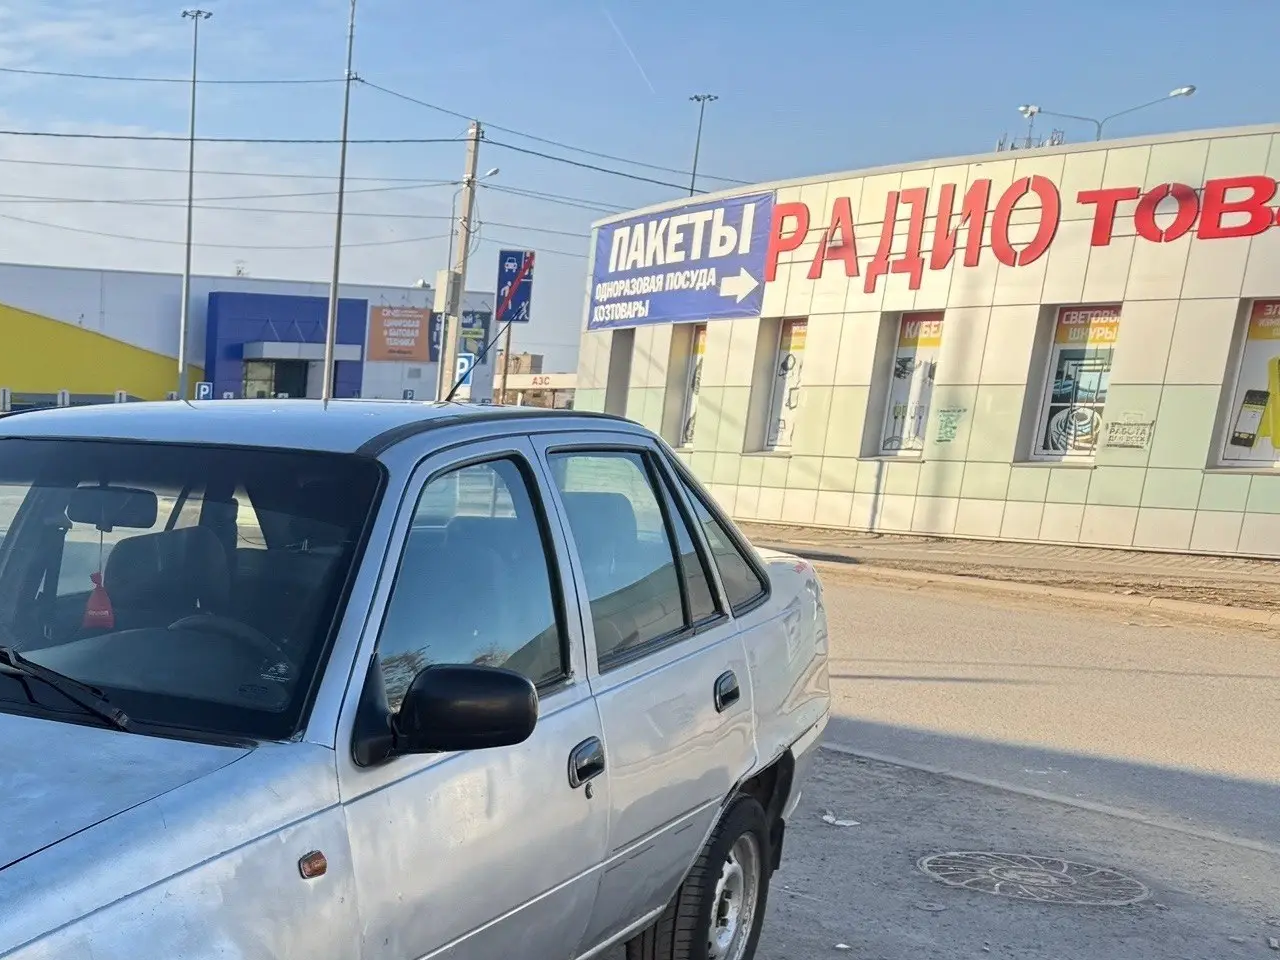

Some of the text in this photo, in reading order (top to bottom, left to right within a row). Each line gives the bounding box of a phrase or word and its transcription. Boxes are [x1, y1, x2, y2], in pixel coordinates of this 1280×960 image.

[608, 203, 756, 273] ПАКЕТЫ
[765, 175, 1280, 293] РАДИО ТОВ
[596, 267, 717, 302] ОДНОРАЗОВАЯ ПОСУДА
[593, 299, 650, 322] ХОЗТОВАРЫ
[905, 321, 943, 338] КАБЕ
[1068, 326, 1117, 340] ШНУРЫ
[532, 376, 550, 386] АЗС
[200, 385, 209, 399] P
